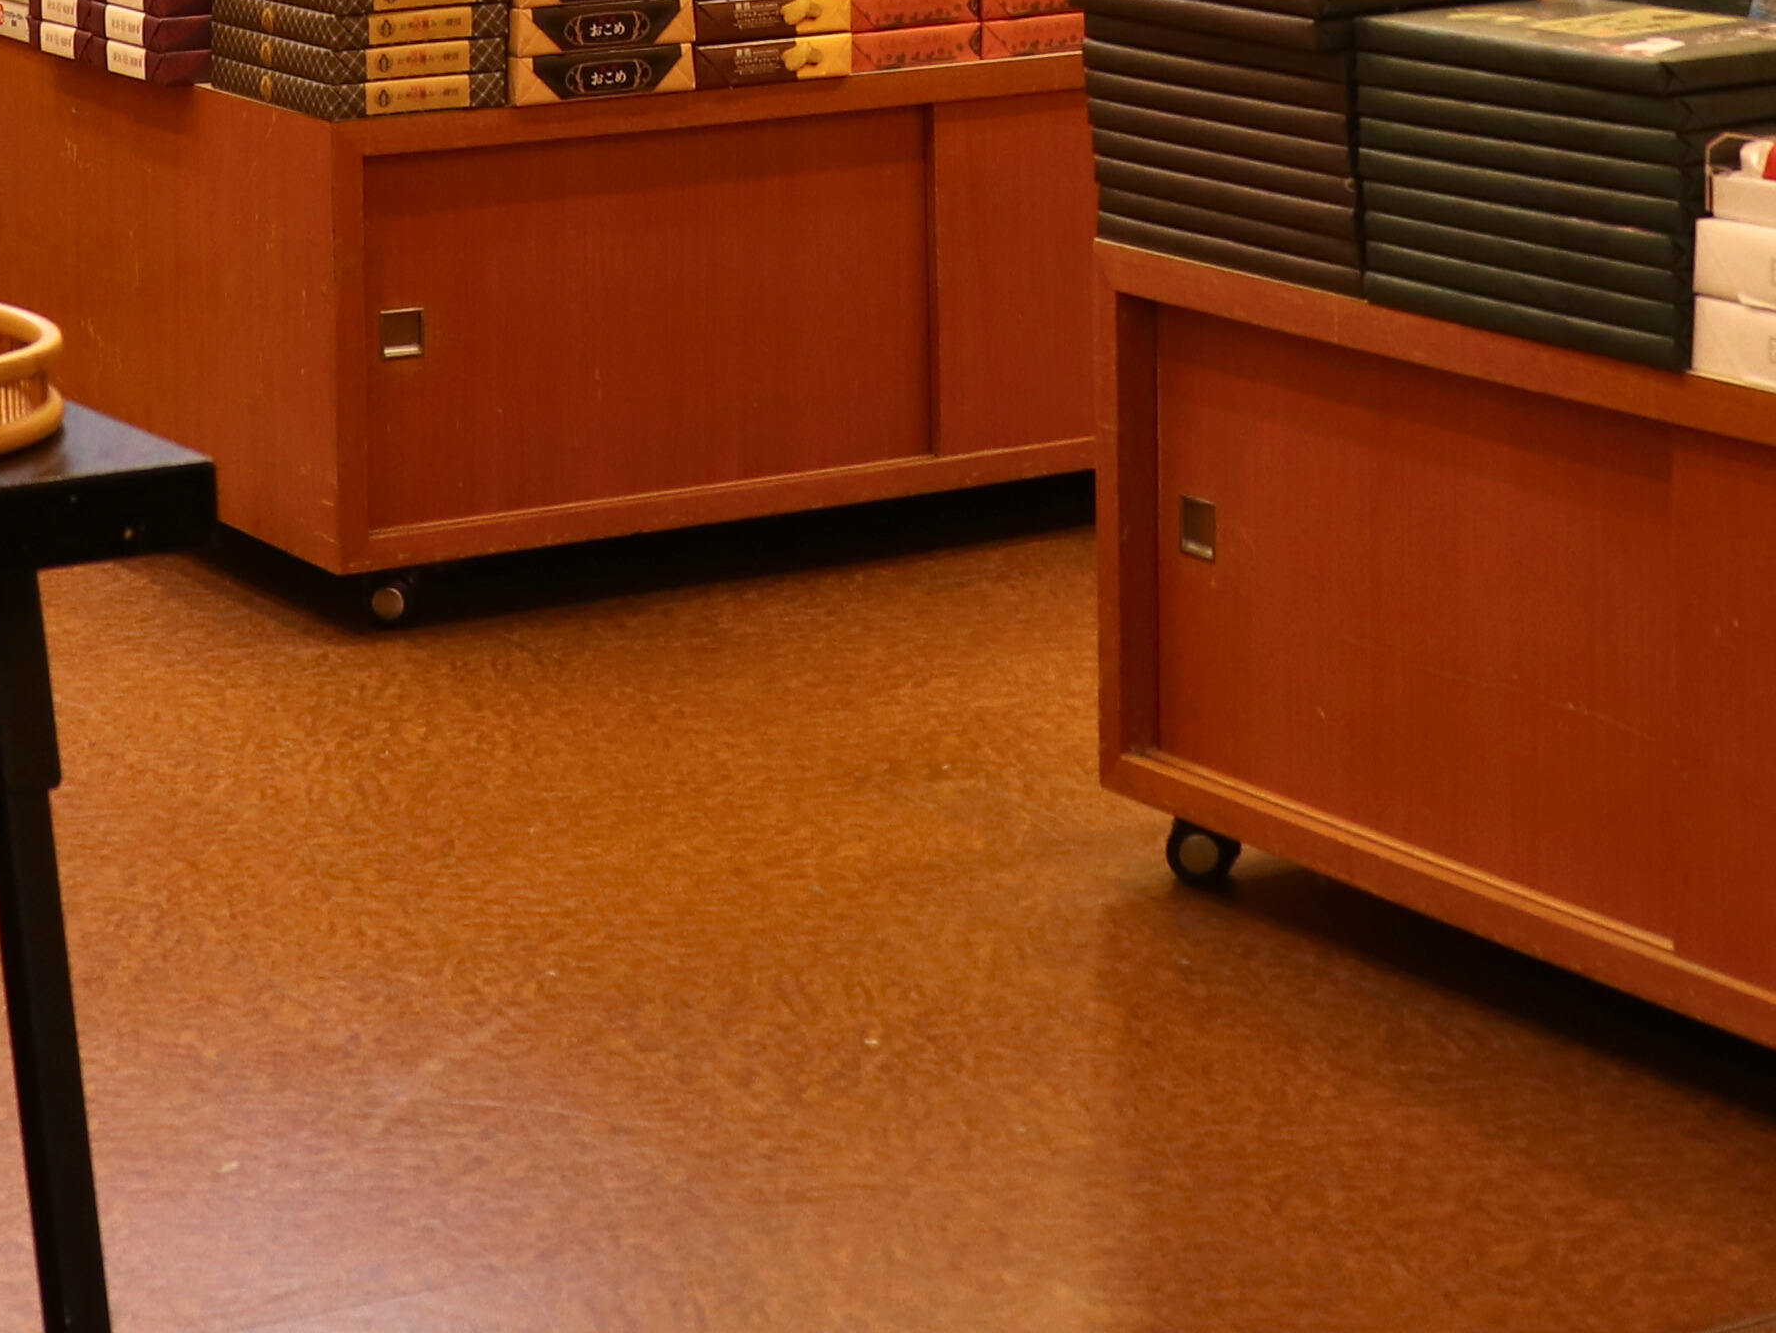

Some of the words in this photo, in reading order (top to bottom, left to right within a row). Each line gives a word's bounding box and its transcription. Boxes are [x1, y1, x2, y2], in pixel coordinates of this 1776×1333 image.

[589, 22, 626, 38] おこめ
[590, 70, 627, 86] おこめ
